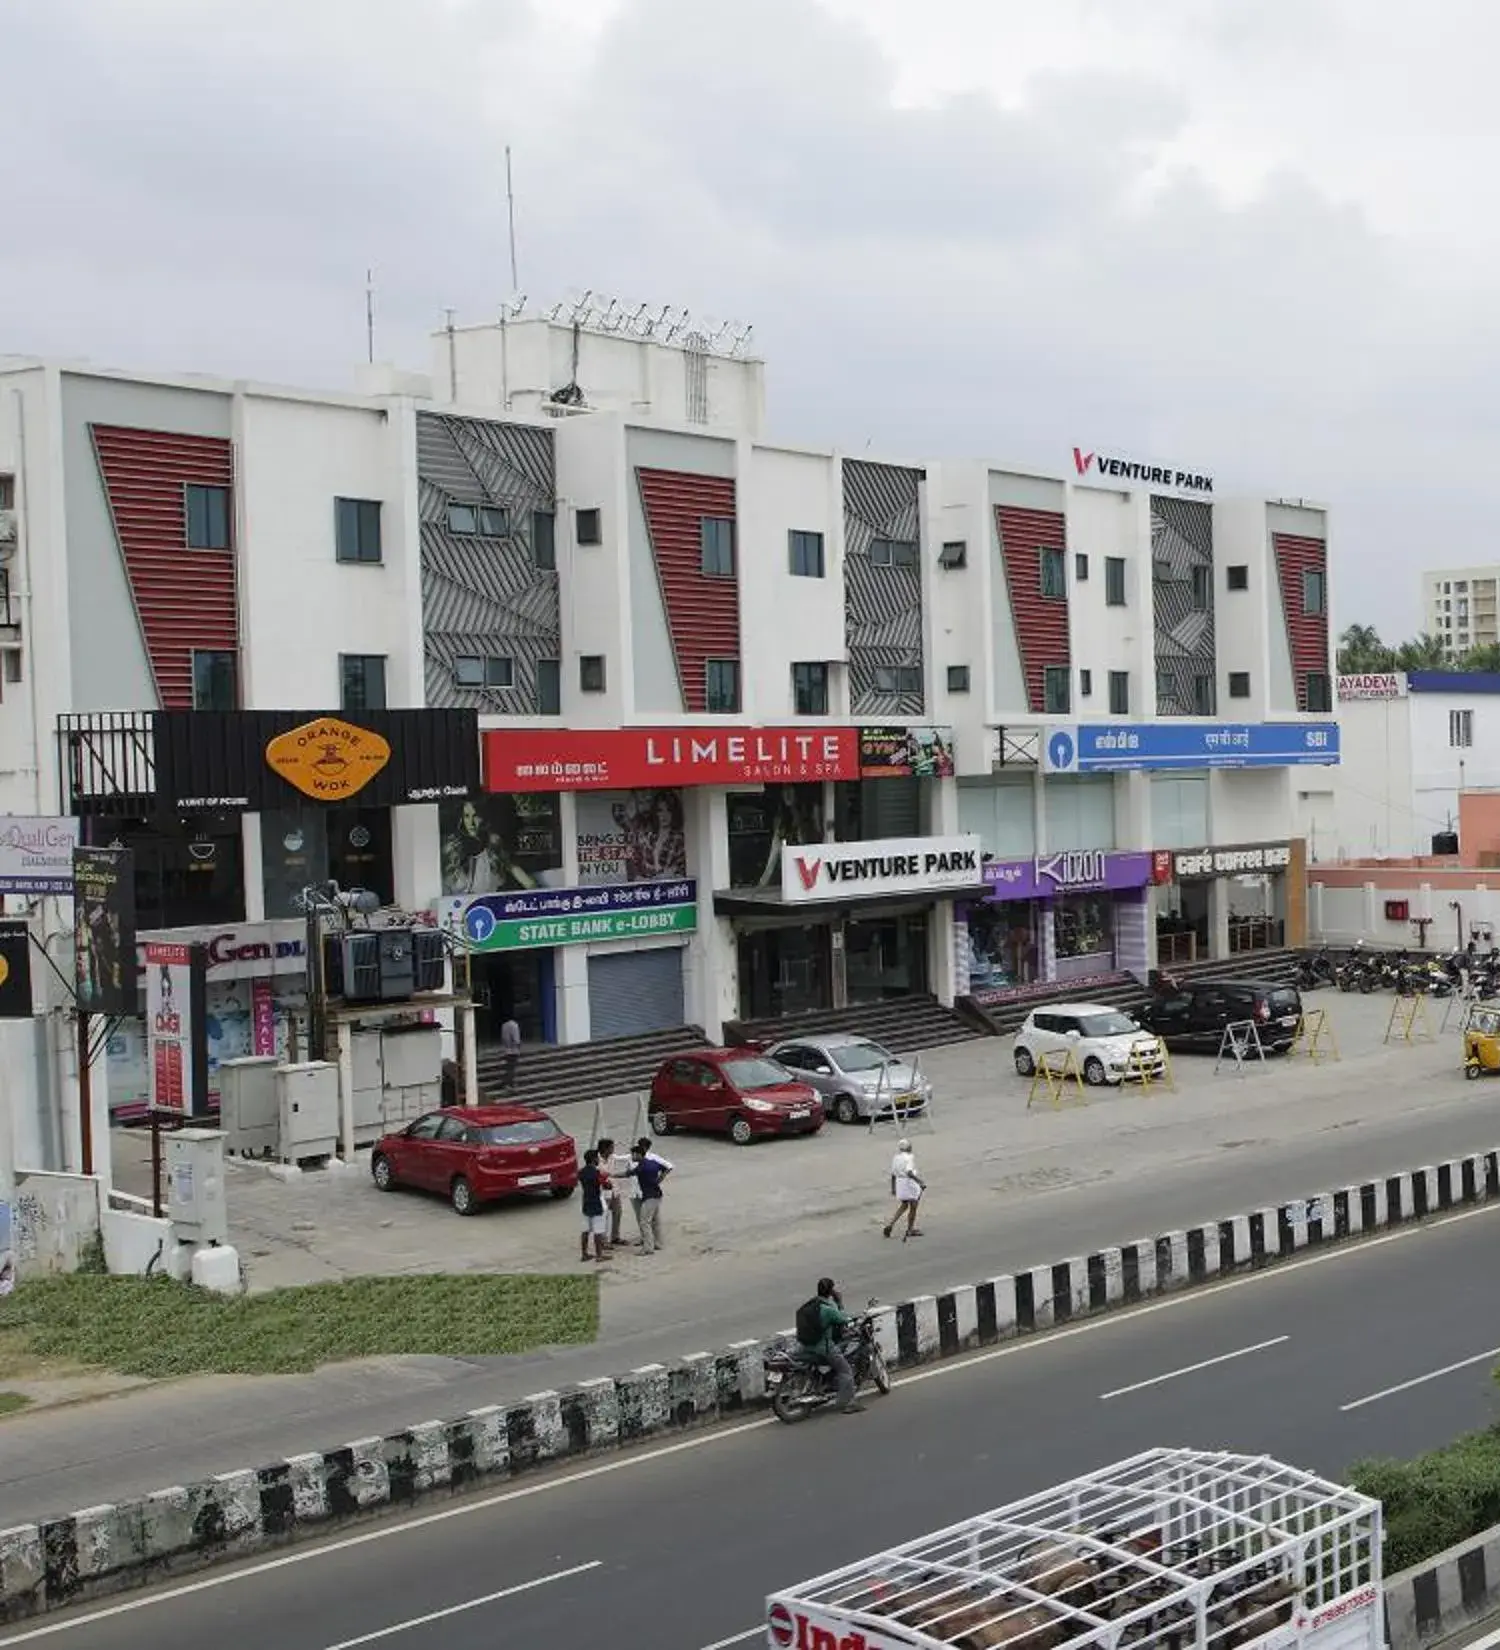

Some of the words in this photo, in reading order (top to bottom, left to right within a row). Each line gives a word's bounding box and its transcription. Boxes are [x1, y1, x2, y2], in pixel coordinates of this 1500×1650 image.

[1097, 456, 1173, 485] VENTURE
[1175, 471, 1213, 492] PARK
[297, 726, 361, 747] ORANGE
[1305, 731, 1328, 748] SBI
[646, 735, 841, 764] LIMELITE
[743, 764, 791, 776] SALON
[800, 763, 808, 774] &
[816, 763, 841, 775] SPA
[312, 778, 350, 792] WOK
[826, 853, 919, 881] VENTURE
[924, 850, 977, 876] PARK
[519, 922, 567, 942] STATE
[571, 918, 614, 936] BANK
[616, 912, 677, 930] e-LOBBY
